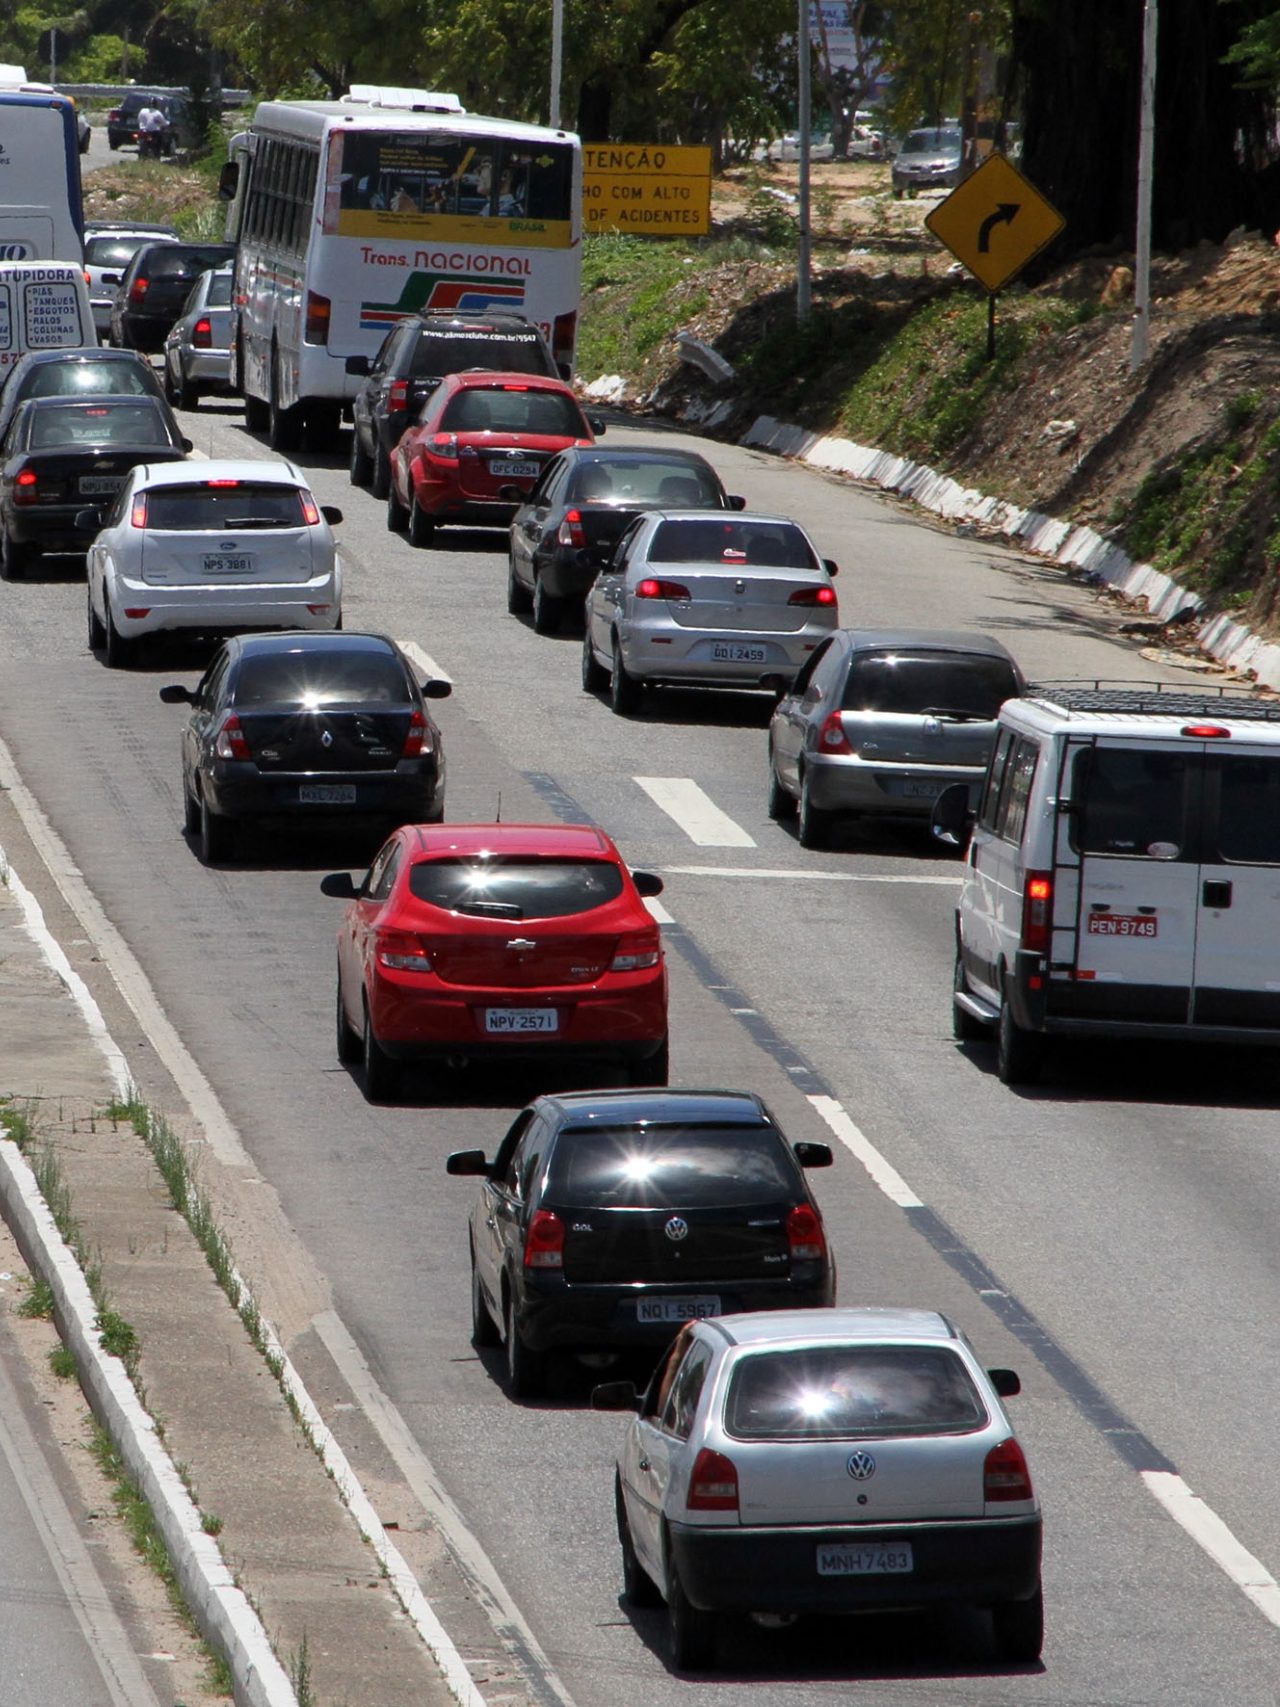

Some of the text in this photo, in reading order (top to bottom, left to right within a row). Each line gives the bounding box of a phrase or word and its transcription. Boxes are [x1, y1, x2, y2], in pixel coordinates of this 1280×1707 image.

[586, 148, 666, 170] TENÇÃO
[583, 185, 690, 199] HO COM ALTO
[620, 209, 700, 223] ACIDENTES
[414, 250, 532, 275] nacional
[32, 287, 53, 296] PIAS
[33, 297, 74, 306] TANQUES
[33, 307, 75, 315] ESGOTOS
[33, 318, 62, 326] RALOS
[33, 327, 74, 335] COLUNAS
[34, 335, 63, 343] VASOS
[572, 1223, 593, 1232] GOL
